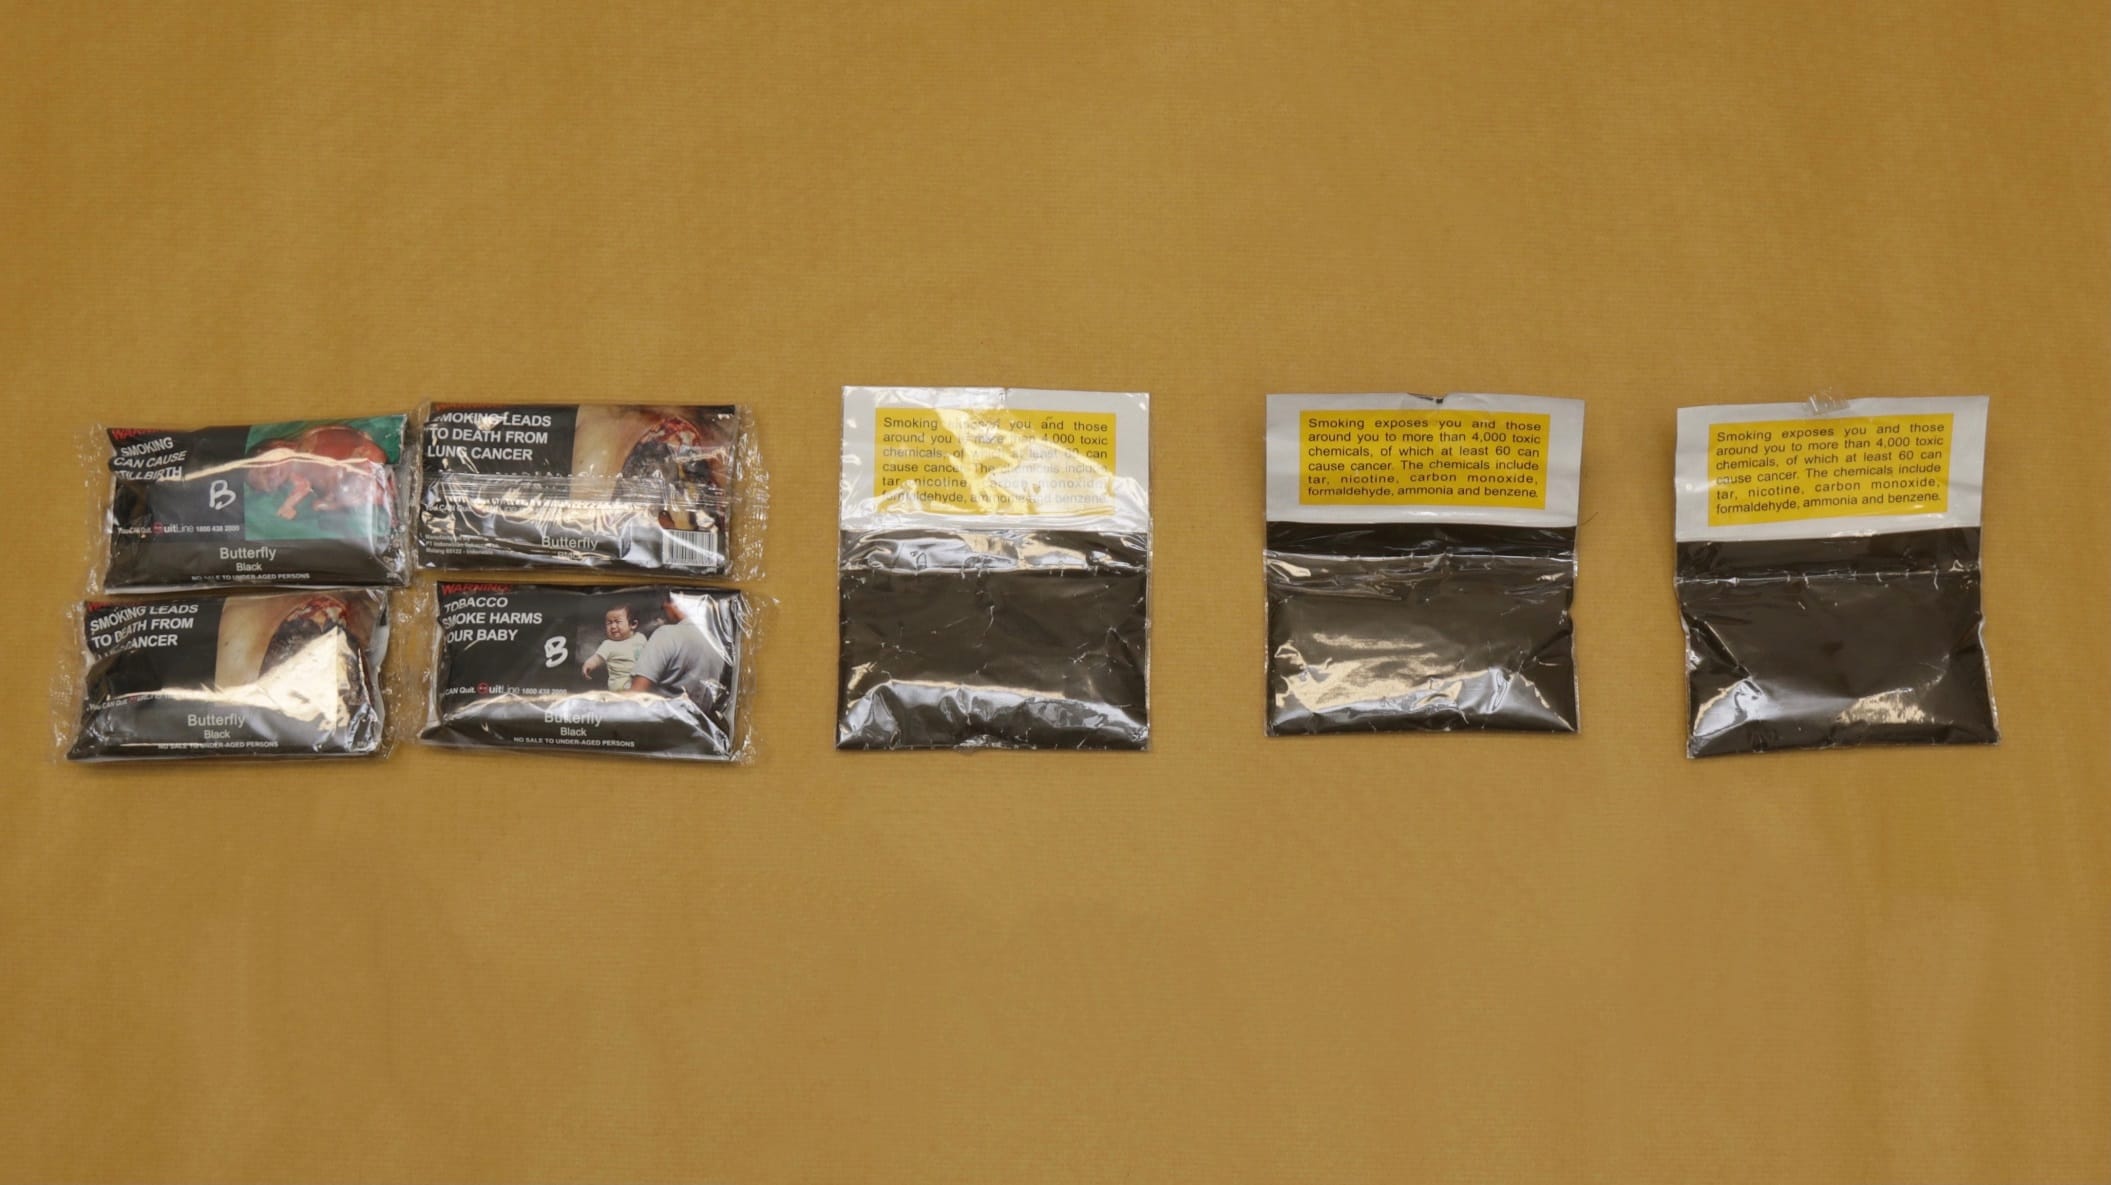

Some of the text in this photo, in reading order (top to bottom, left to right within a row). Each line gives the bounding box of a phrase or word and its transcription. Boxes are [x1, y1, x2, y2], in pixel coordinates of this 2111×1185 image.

[503, 413, 552, 427] LEADS
[883, 417, 938, 431] Smoking
[1010, 419, 1031, 431] you
[1041, 420, 1064, 430] and
[1074, 421, 1108, 432] those
[1308, 418, 1541, 431] Smoking exposes you and those
[430, 427, 548, 444] TO DEATH FROM
[883, 432, 925, 444] around
[930, 435, 952, 445] you
[1081, 434, 1108, 445] toxic
[1308, 432, 1541, 444] around you to more than 4,000 toxic
[1717, 423, 1945, 442] Smoking exposes you and those
[120, 437, 174, 457] SMOKING
[427, 445, 534, 461] LUNG CANCER
[883, 447, 947, 461] chemicals,
[1086, 450, 1108, 459] can
[1308, 446, 1540, 457] chemicals, of which at least 60 can
[1716, 437, 1944, 456] around you to more than 4,000 toxic
[113, 450, 188, 468] CAN CAUSE
[1308, 460, 1539, 471] cause cancer. The chemicals include
[1716, 450, 1942, 470] chemicals, of which at least 60 can
[118, 466, 182, 481] TILLBIRTH
[882, 463, 919, 472] cause
[1716, 463, 1941, 485] cause cancer. The chemicals include
[1308, 473, 1538, 485] tar, nicotine, carbon monoxide,
[209, 480, 237, 510] B
[1308, 485, 1538, 498] formaldehyde, ammonia and benzene.
[1717, 478, 1940, 500] tar, nicotine, carbon monoxide,
[1716, 492, 1941, 514] formaldehyde, ammonia and benzene.
[542, 536, 599, 550] Butterfly
[220, 547, 276, 560] Butterfly
[236, 562, 262, 572] Black
[444, 597, 508, 613] TOBACCO
[90, 606, 146, 632] SMOKING
[149, 604, 199, 614] LEADS
[442, 612, 543, 629] SMOKE HARMS
[92, 618, 194, 648] TO DEATH FROM
[476, 629, 518, 641] BABY
[544, 636, 568, 668] B
[187, 714, 245, 728] Butterfly
[544, 712, 602, 727] Butterfly
[203, 730, 231, 739] Black
[560, 727, 587, 737] Black
